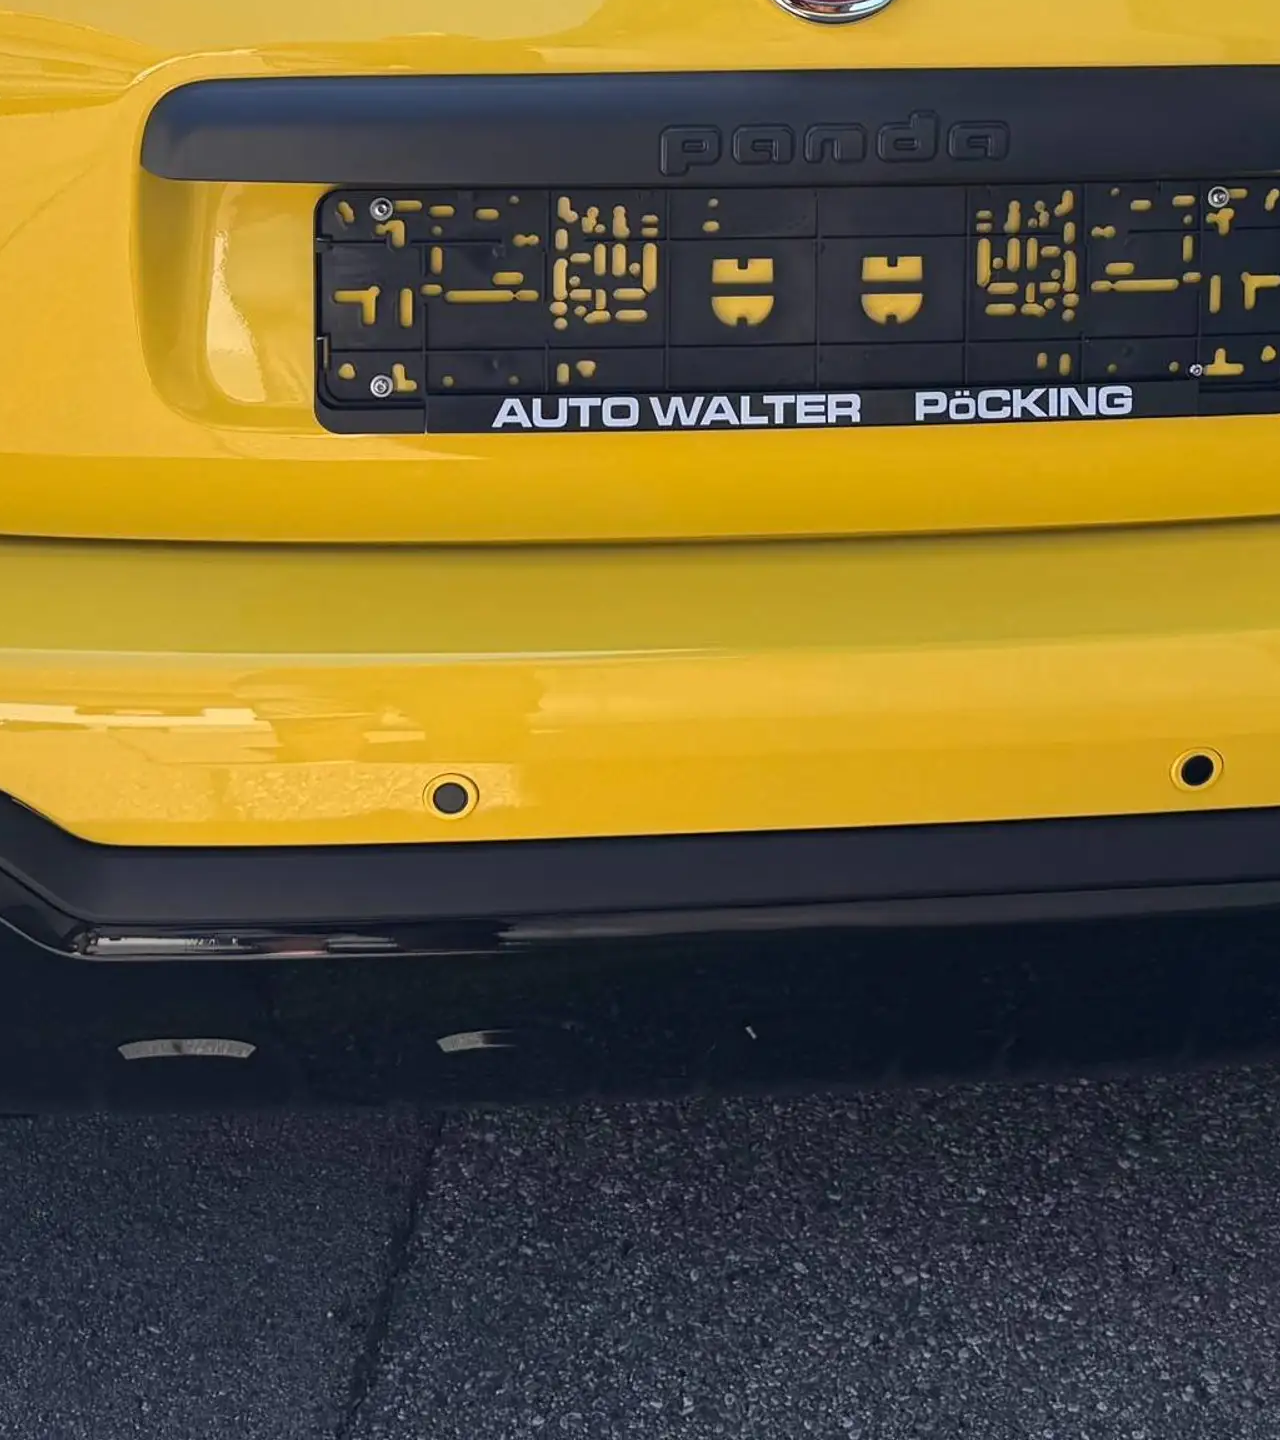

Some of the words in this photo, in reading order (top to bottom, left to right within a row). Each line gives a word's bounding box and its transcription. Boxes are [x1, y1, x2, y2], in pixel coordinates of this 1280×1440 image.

[658, 109, 1012, 178] panda
[491, 396, 640, 428] AUTO
[649, 393, 862, 427] WALTER
